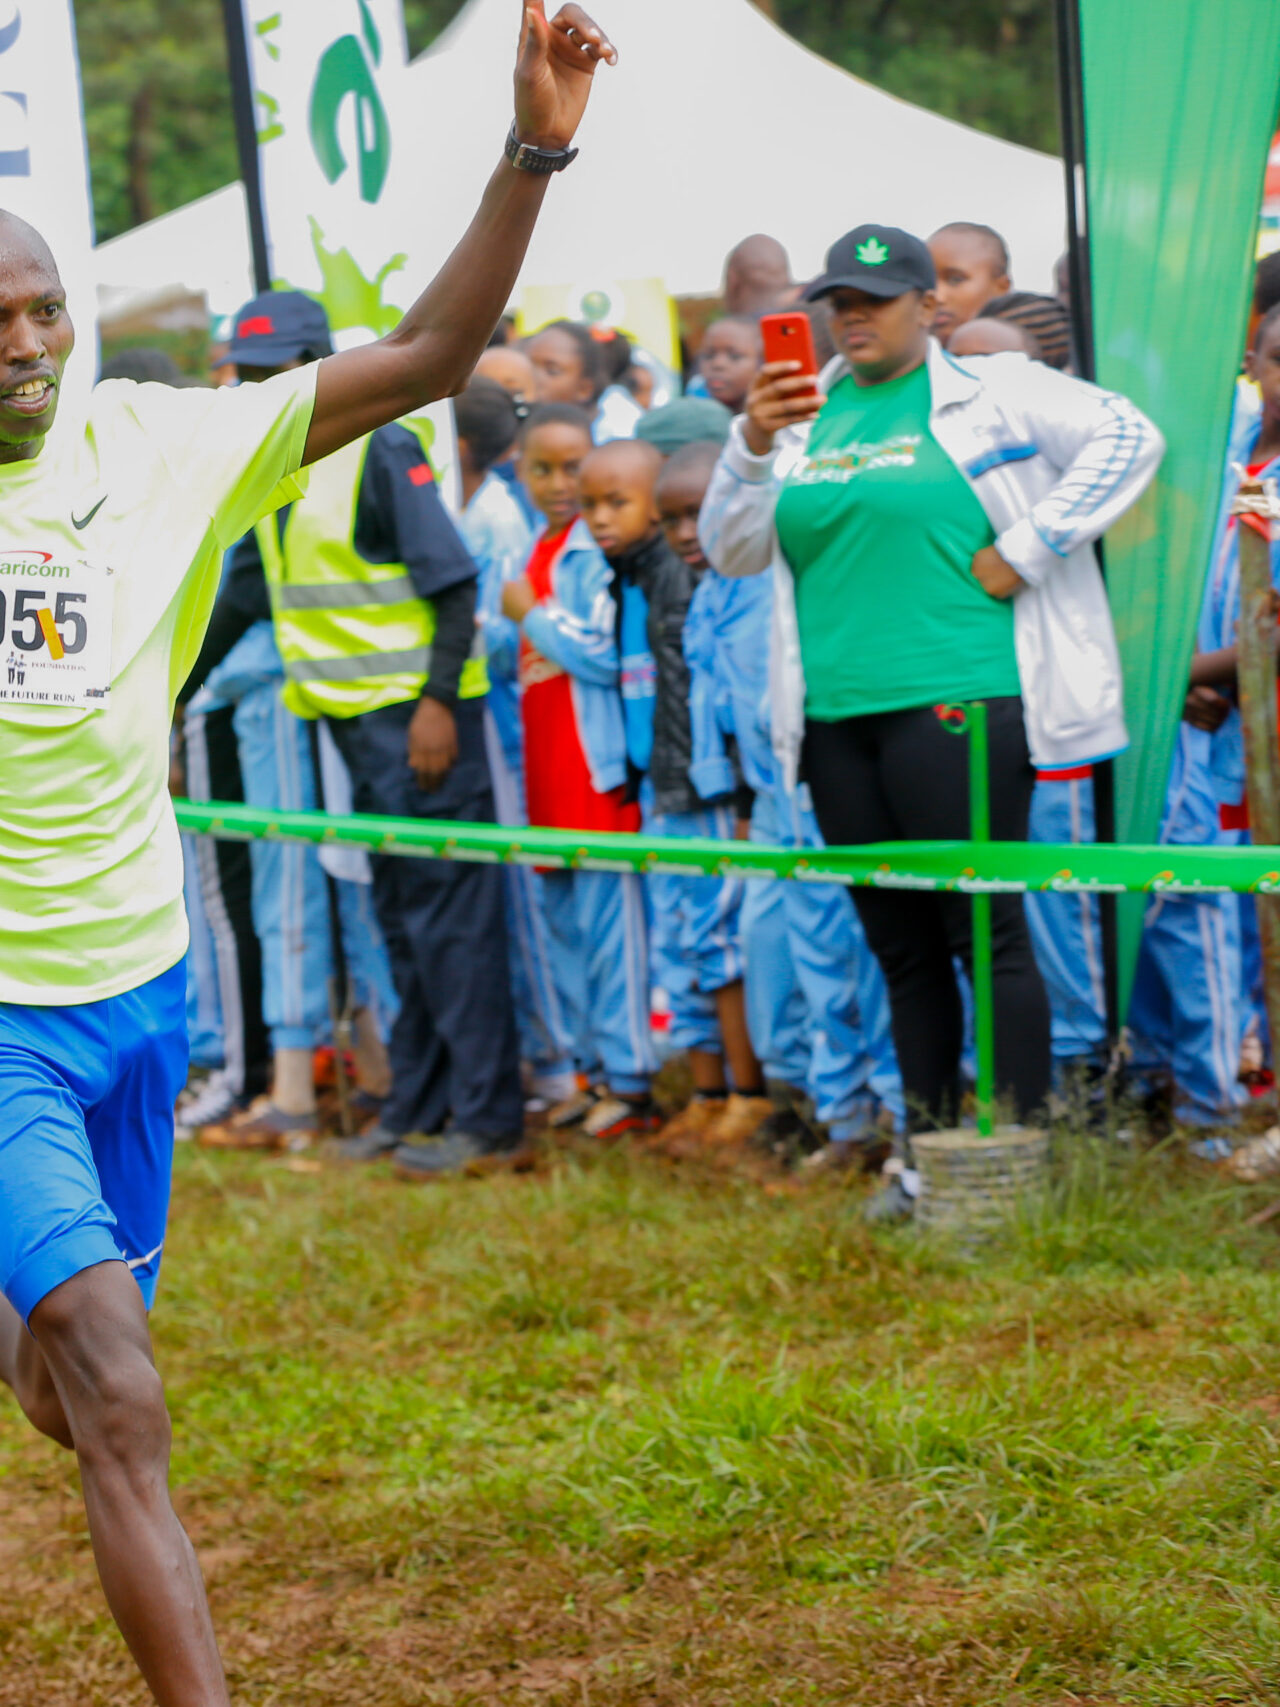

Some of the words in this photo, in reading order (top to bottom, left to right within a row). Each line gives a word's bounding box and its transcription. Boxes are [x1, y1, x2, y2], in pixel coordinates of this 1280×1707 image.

[31, 661, 87, 672] FOUNDATION
[11, 690, 49, 700] FUTURE
[53, 692, 75, 702] RUN
